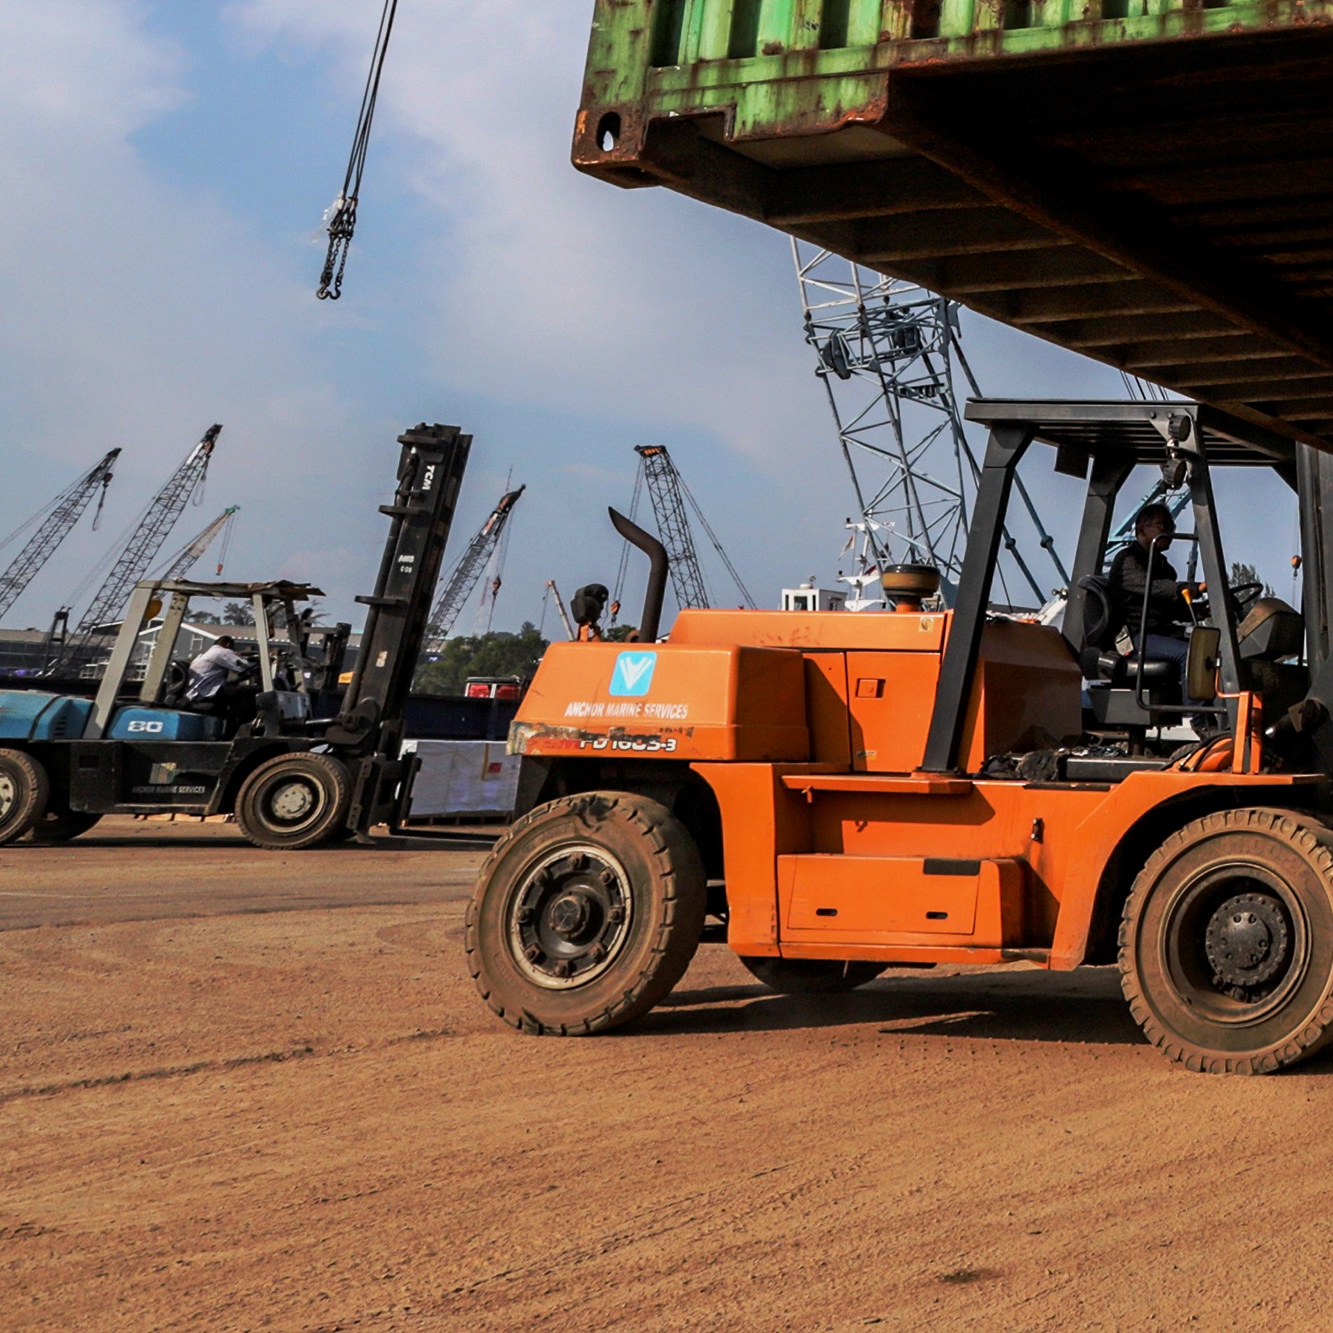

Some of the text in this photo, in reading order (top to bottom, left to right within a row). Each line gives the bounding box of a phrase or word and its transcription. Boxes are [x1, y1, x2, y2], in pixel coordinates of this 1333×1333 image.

[422, 465, 435, 490] TCM
[564, 702, 688, 719] ANCHOR MARINE SERVICES
[127, 721, 163, 733] 80
[178, 786, 205, 794] SERVICES
